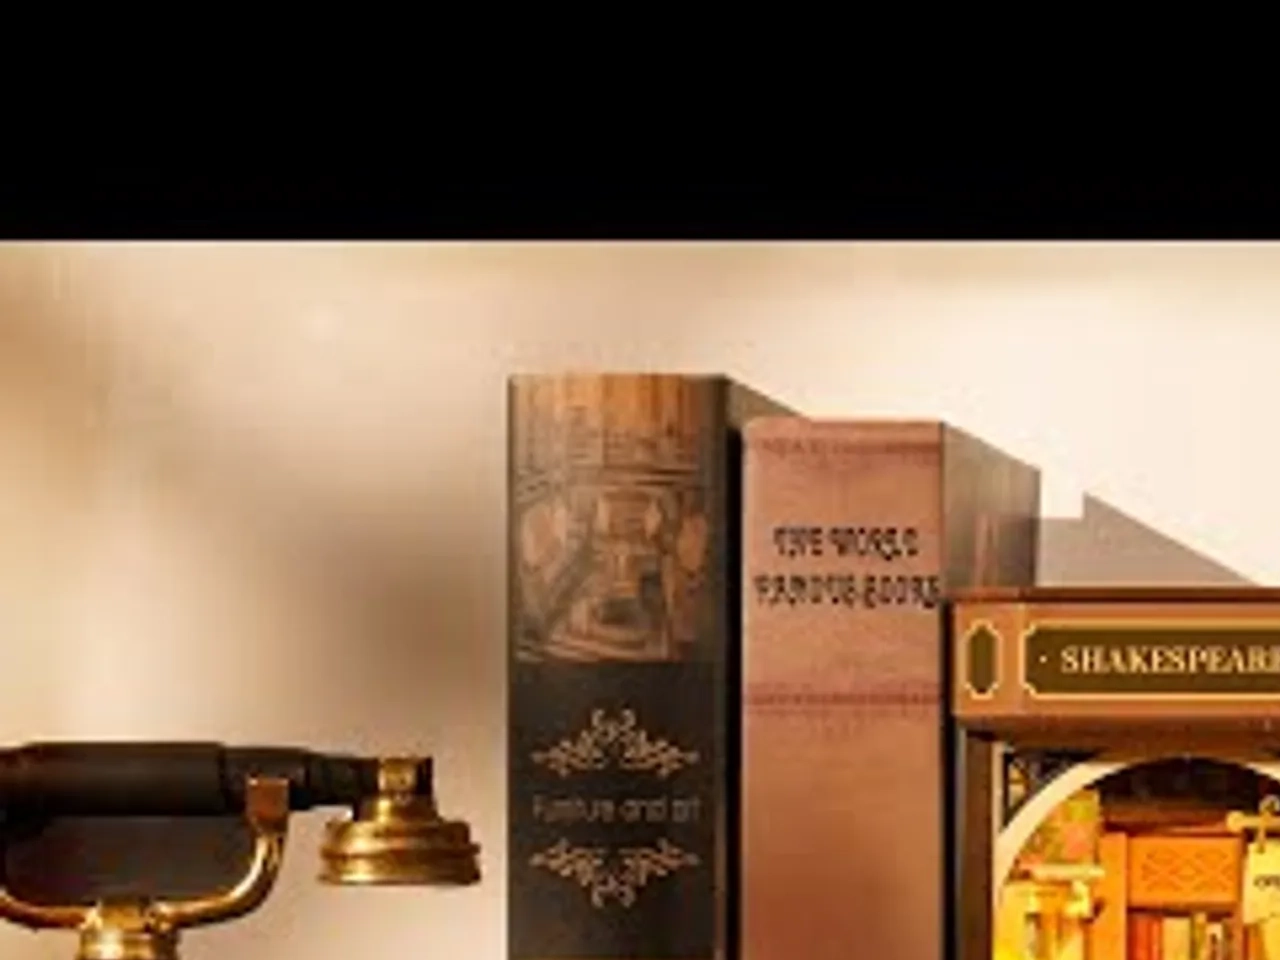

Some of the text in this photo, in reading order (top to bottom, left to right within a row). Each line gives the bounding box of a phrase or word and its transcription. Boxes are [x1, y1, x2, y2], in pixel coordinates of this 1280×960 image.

[773, 526, 920, 562] THE WORLD
[753, 574, 855, 609] FAMOUS
